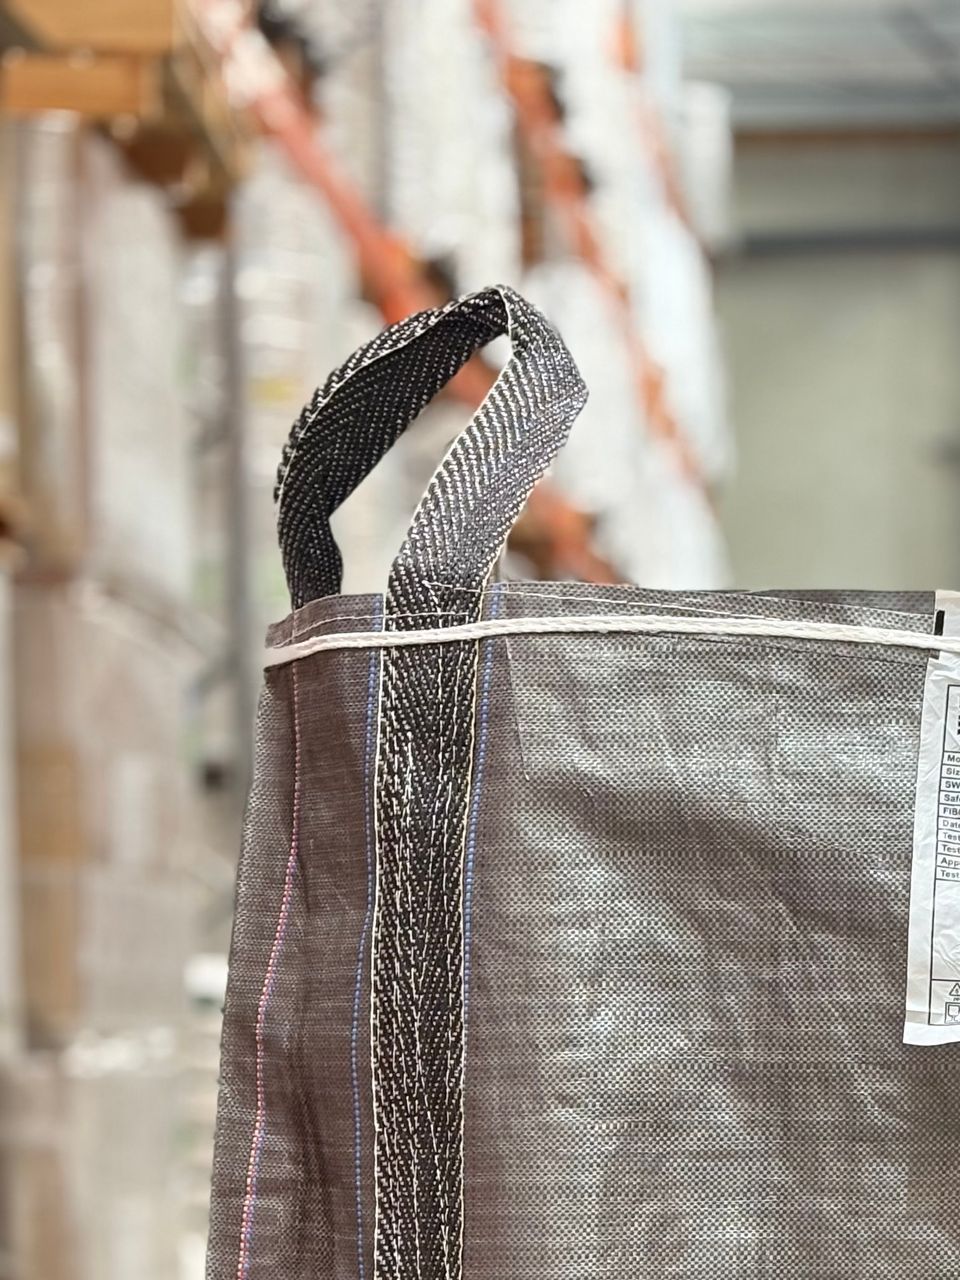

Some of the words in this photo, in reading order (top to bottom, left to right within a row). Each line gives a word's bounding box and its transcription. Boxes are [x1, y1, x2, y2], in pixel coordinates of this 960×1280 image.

[942, 831, 960, 839] Test
[942, 844, 960, 854] Test
[940, 870, 960, 878] Test
